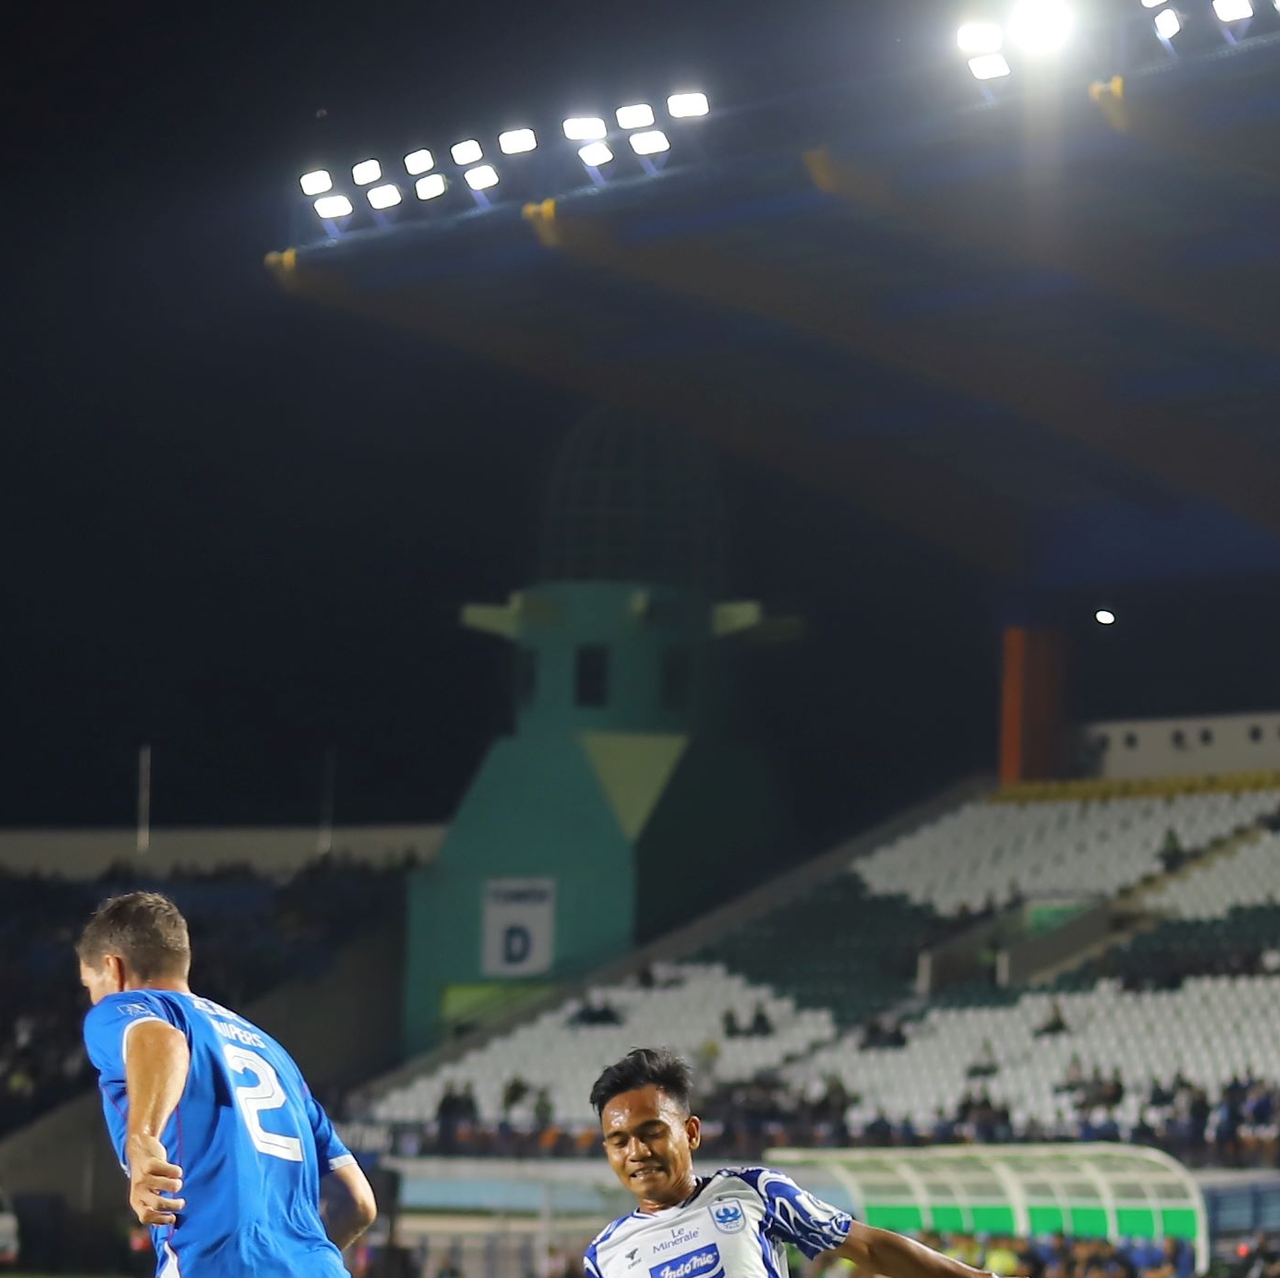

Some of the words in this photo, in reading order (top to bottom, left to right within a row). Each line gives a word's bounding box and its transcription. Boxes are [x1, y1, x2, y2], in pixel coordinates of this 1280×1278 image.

[504, 925, 533, 965] D
[224, 1044, 304, 1162] 2
[652, 1230, 699, 1254] Minerale
[671, 1227, 685, 1239] Le
